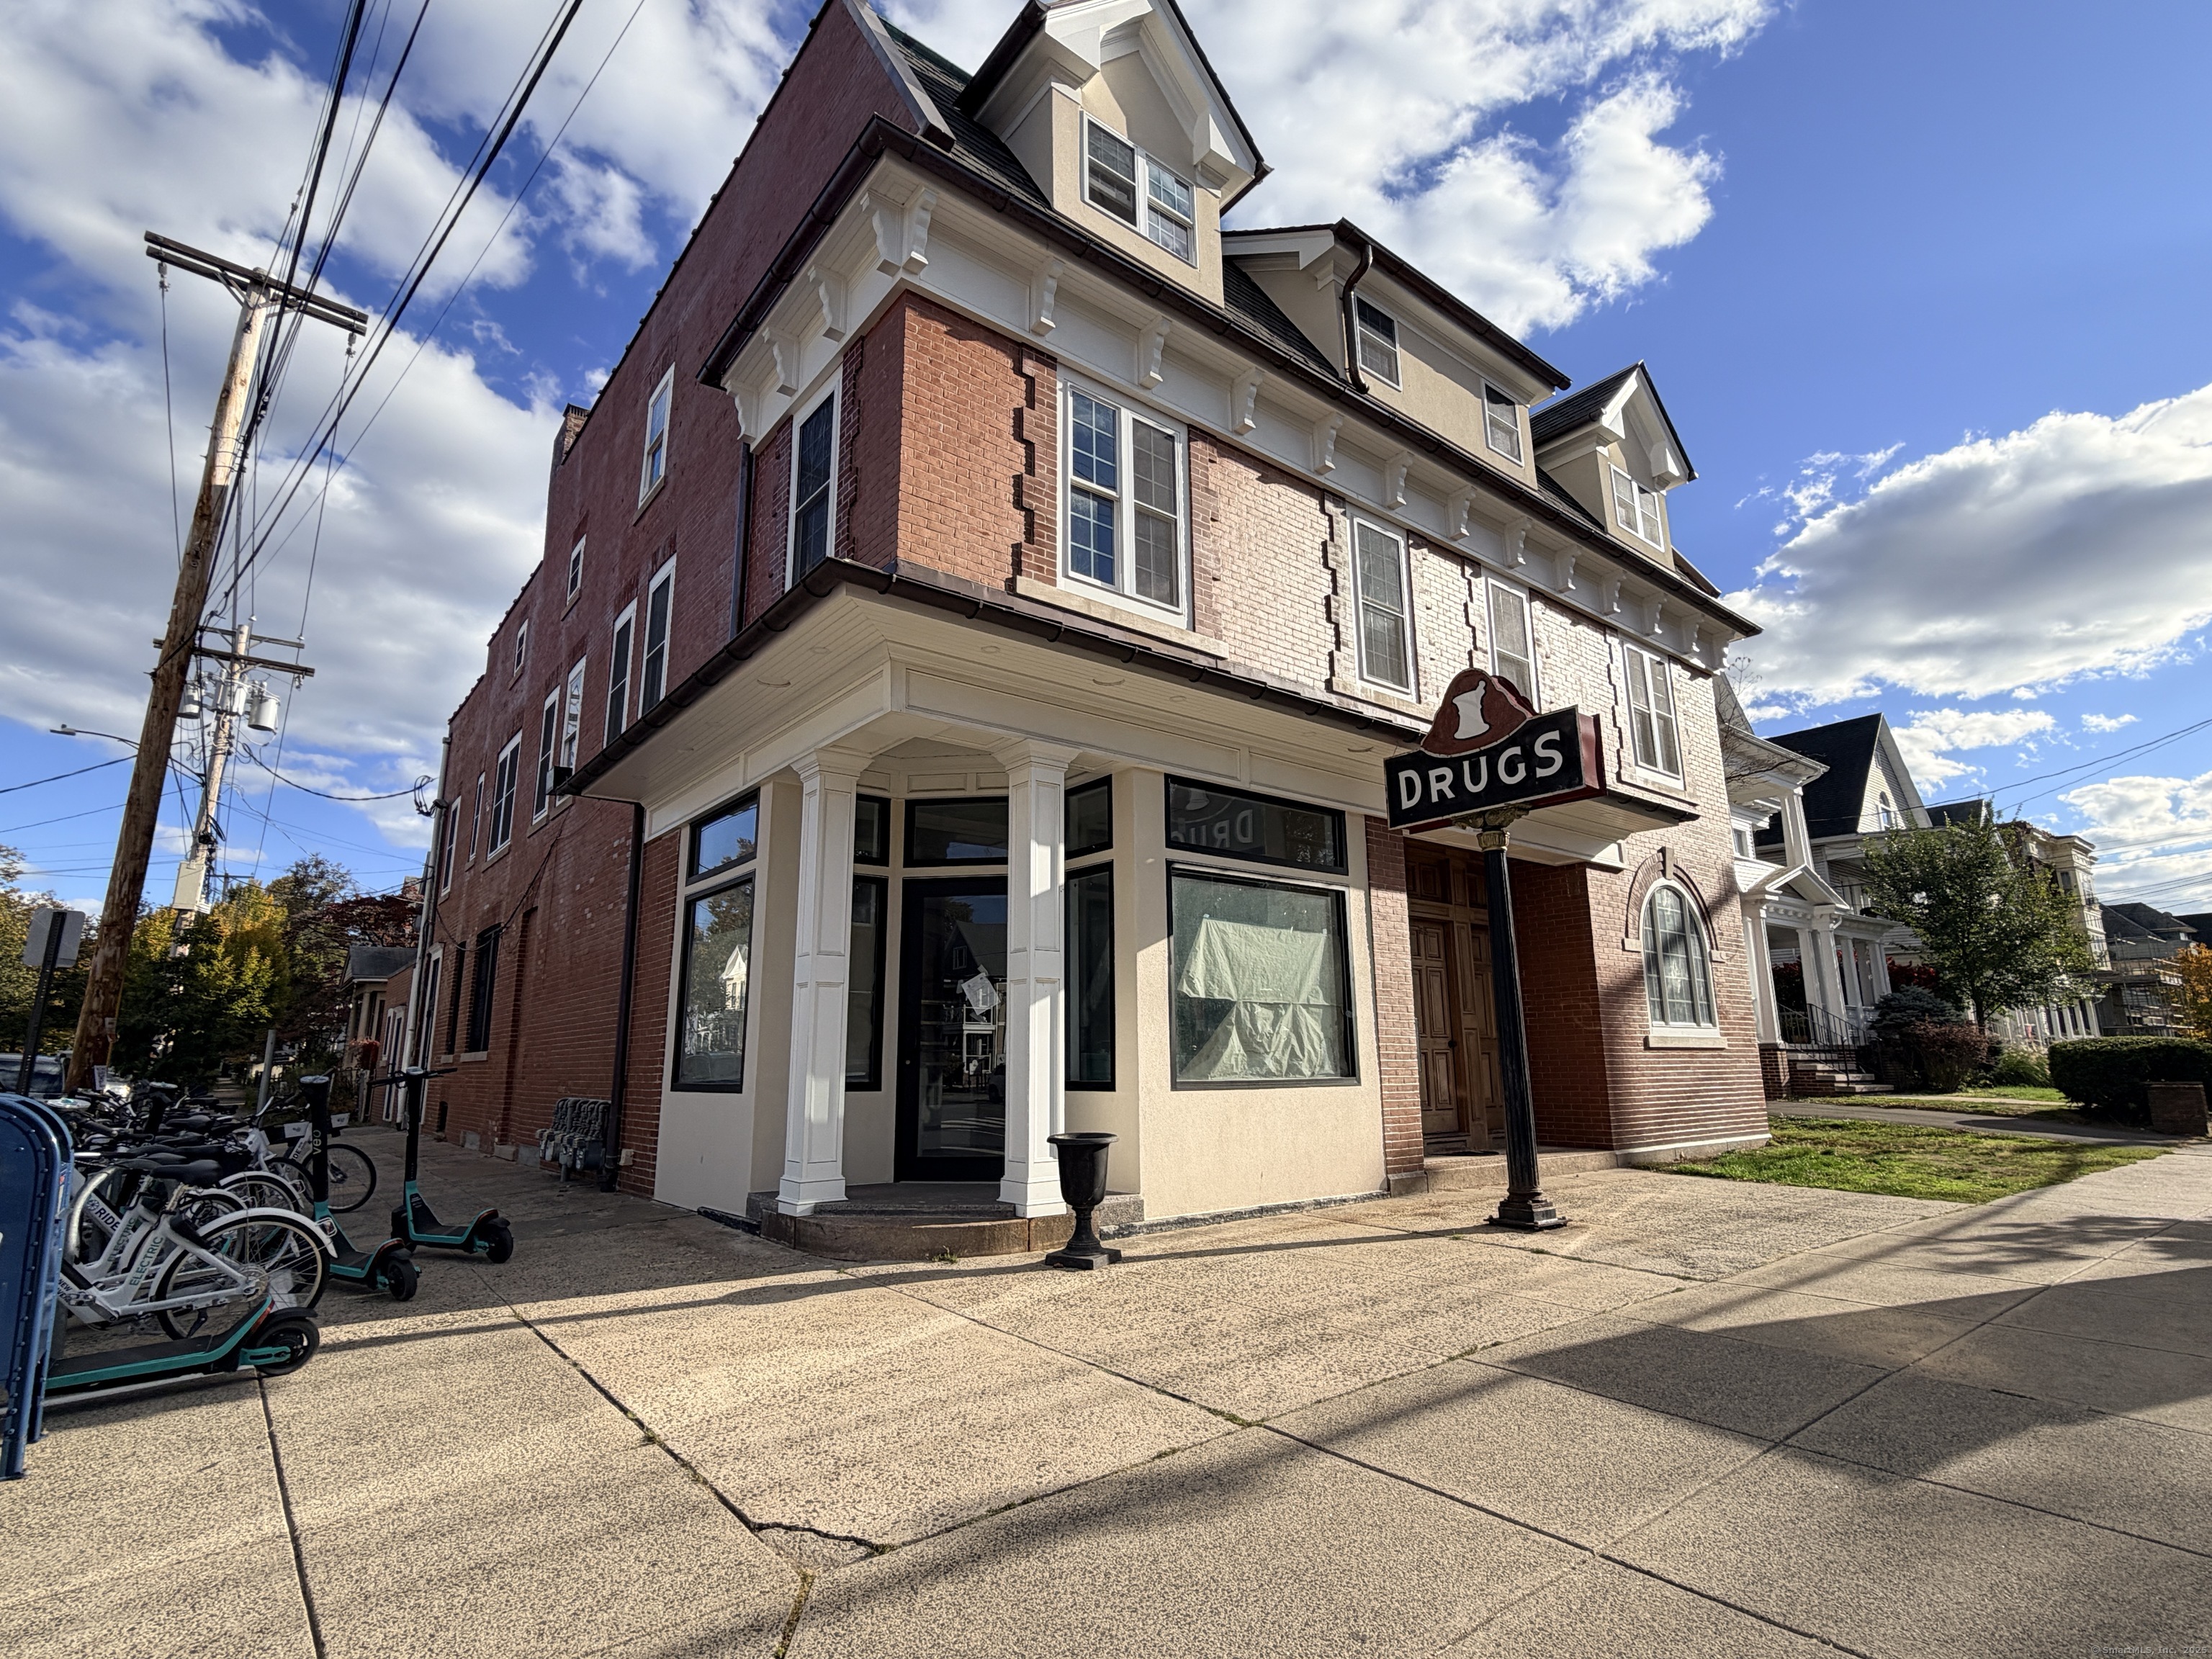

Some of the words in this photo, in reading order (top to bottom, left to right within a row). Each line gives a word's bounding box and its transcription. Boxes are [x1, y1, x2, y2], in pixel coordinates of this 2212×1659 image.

[1398, 729, 1563, 810] DRUGS
[313, 1129, 322, 1155] veo
[94, 1208, 121, 1231] RIDE
[107, 1216, 137, 1262] ELECTRIC
[129, 1236, 163, 1286] ELECTRIC
